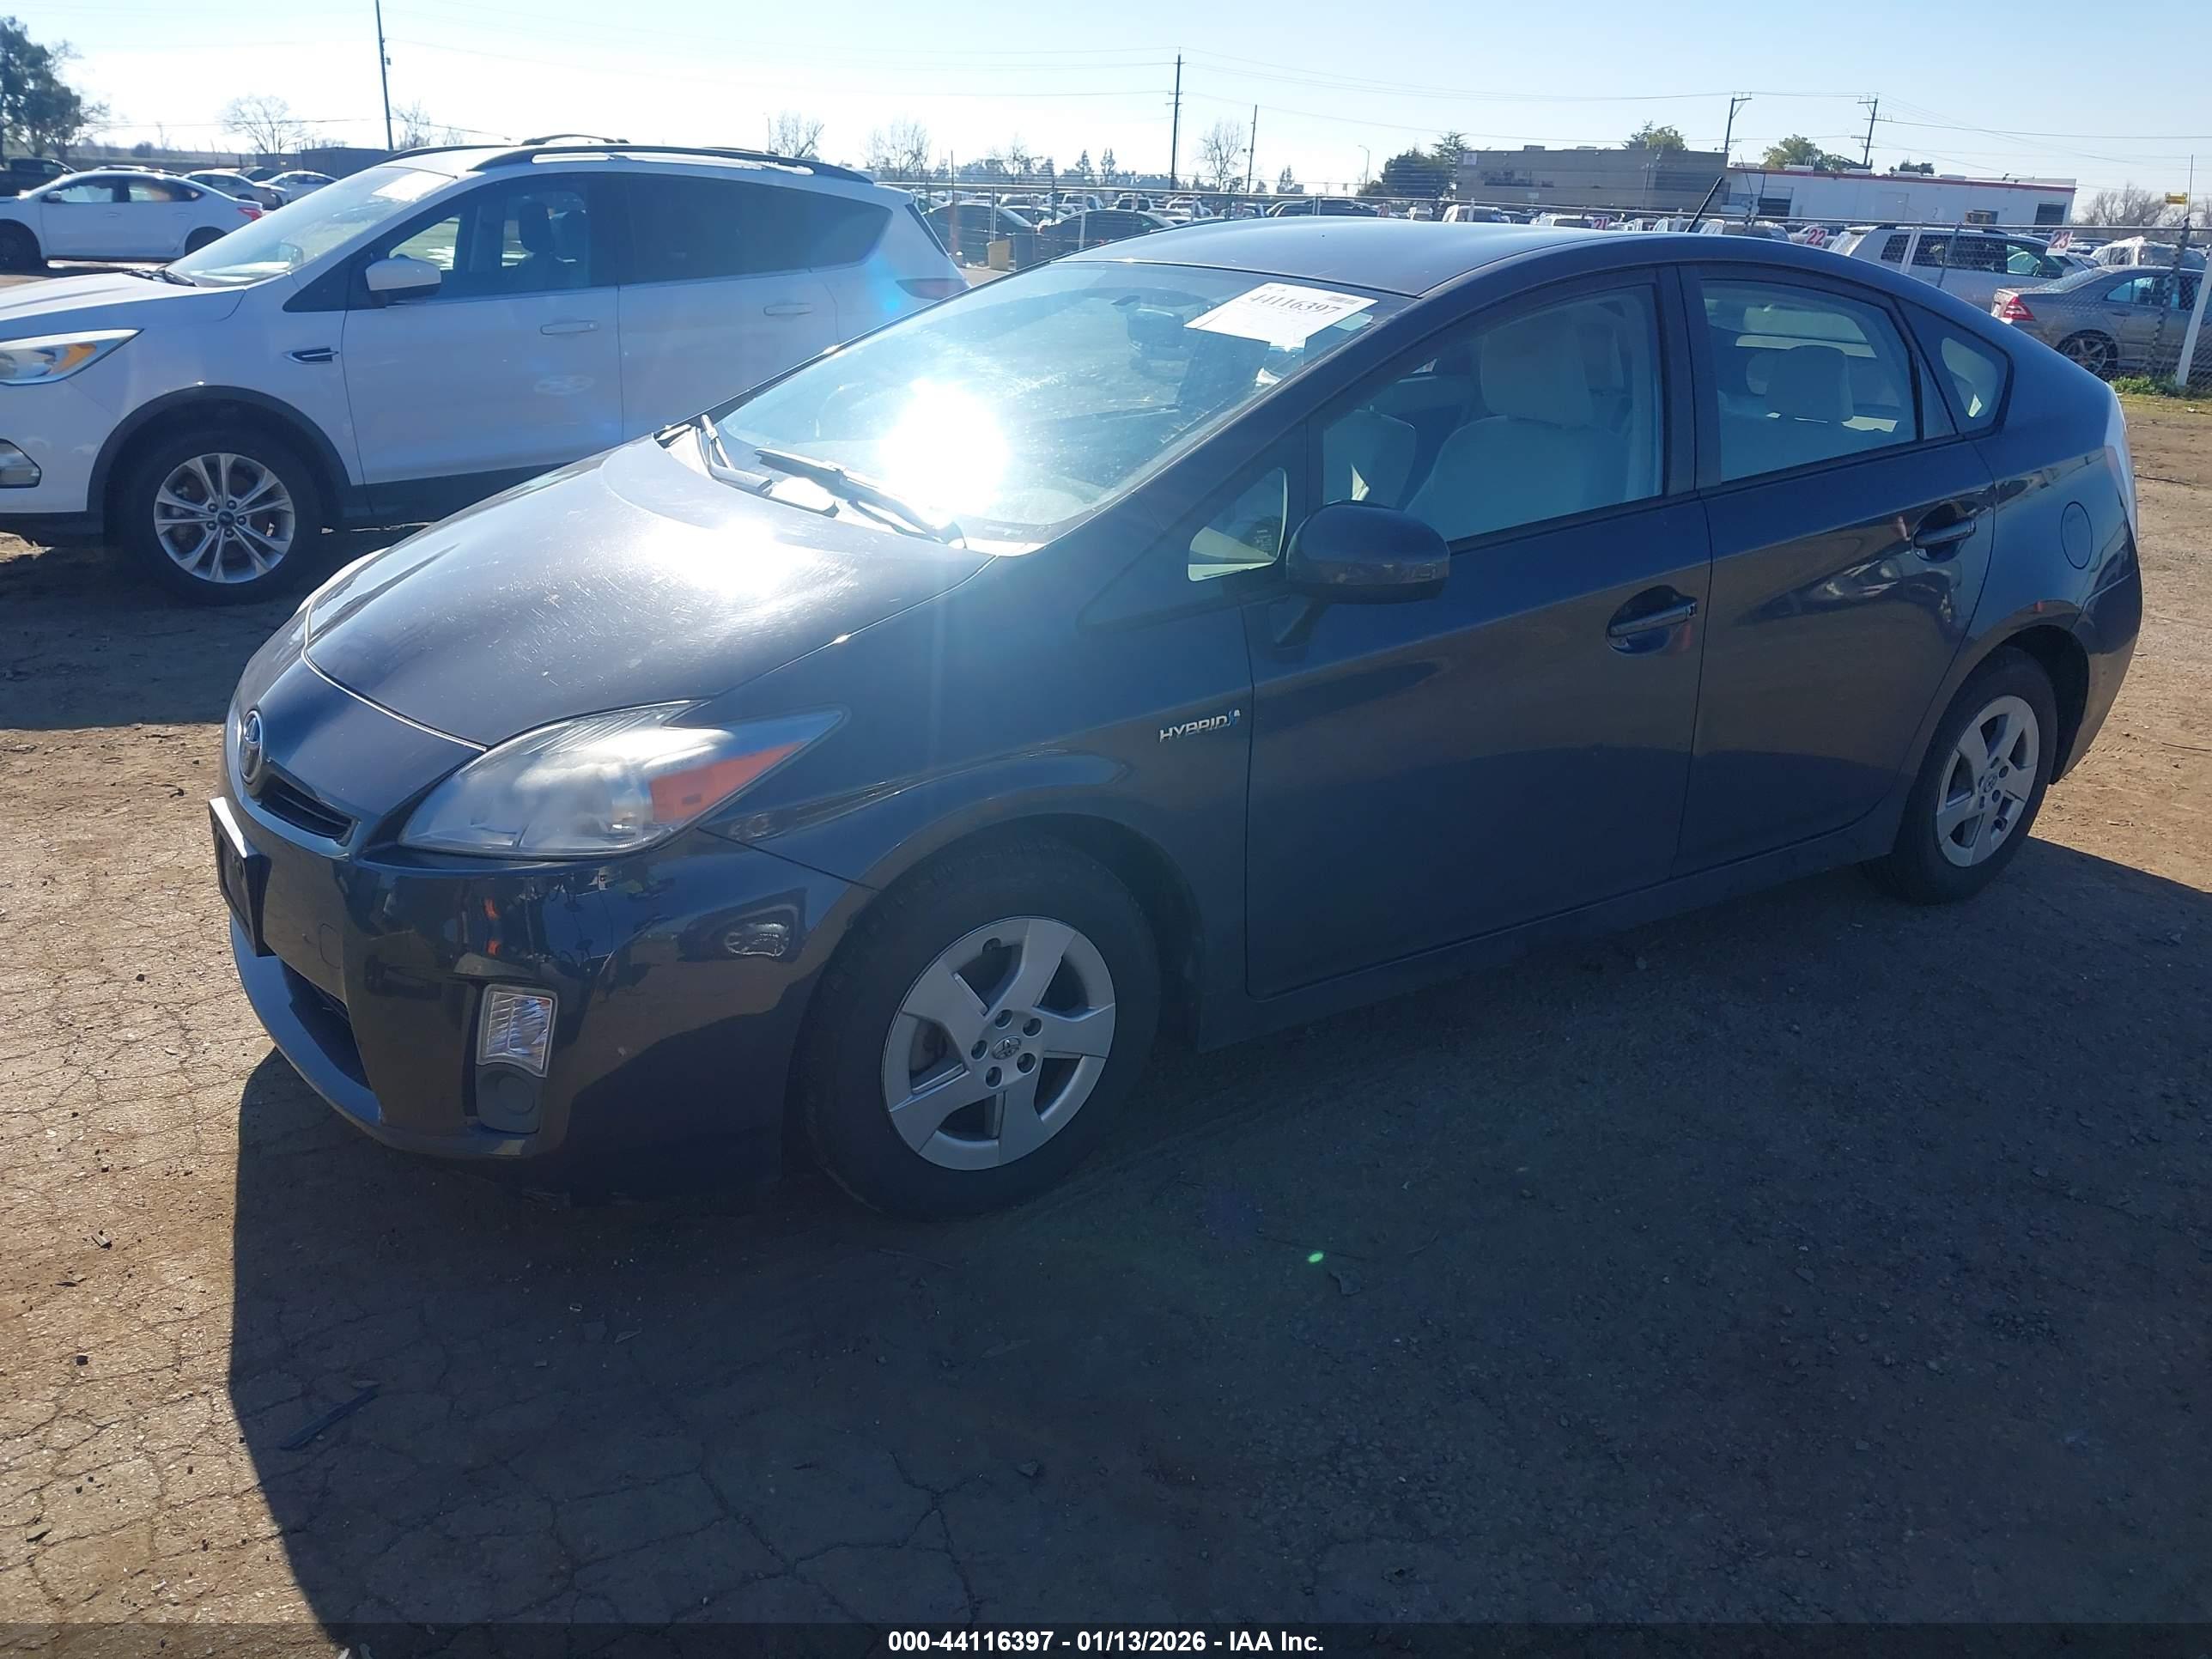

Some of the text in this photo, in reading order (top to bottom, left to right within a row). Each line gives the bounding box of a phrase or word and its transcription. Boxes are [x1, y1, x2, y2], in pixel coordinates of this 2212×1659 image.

[1806, 228, 1826, 246] 22
[2050, 230, 2071, 249] 23
[1159, 715, 1229, 742] HYBRID
